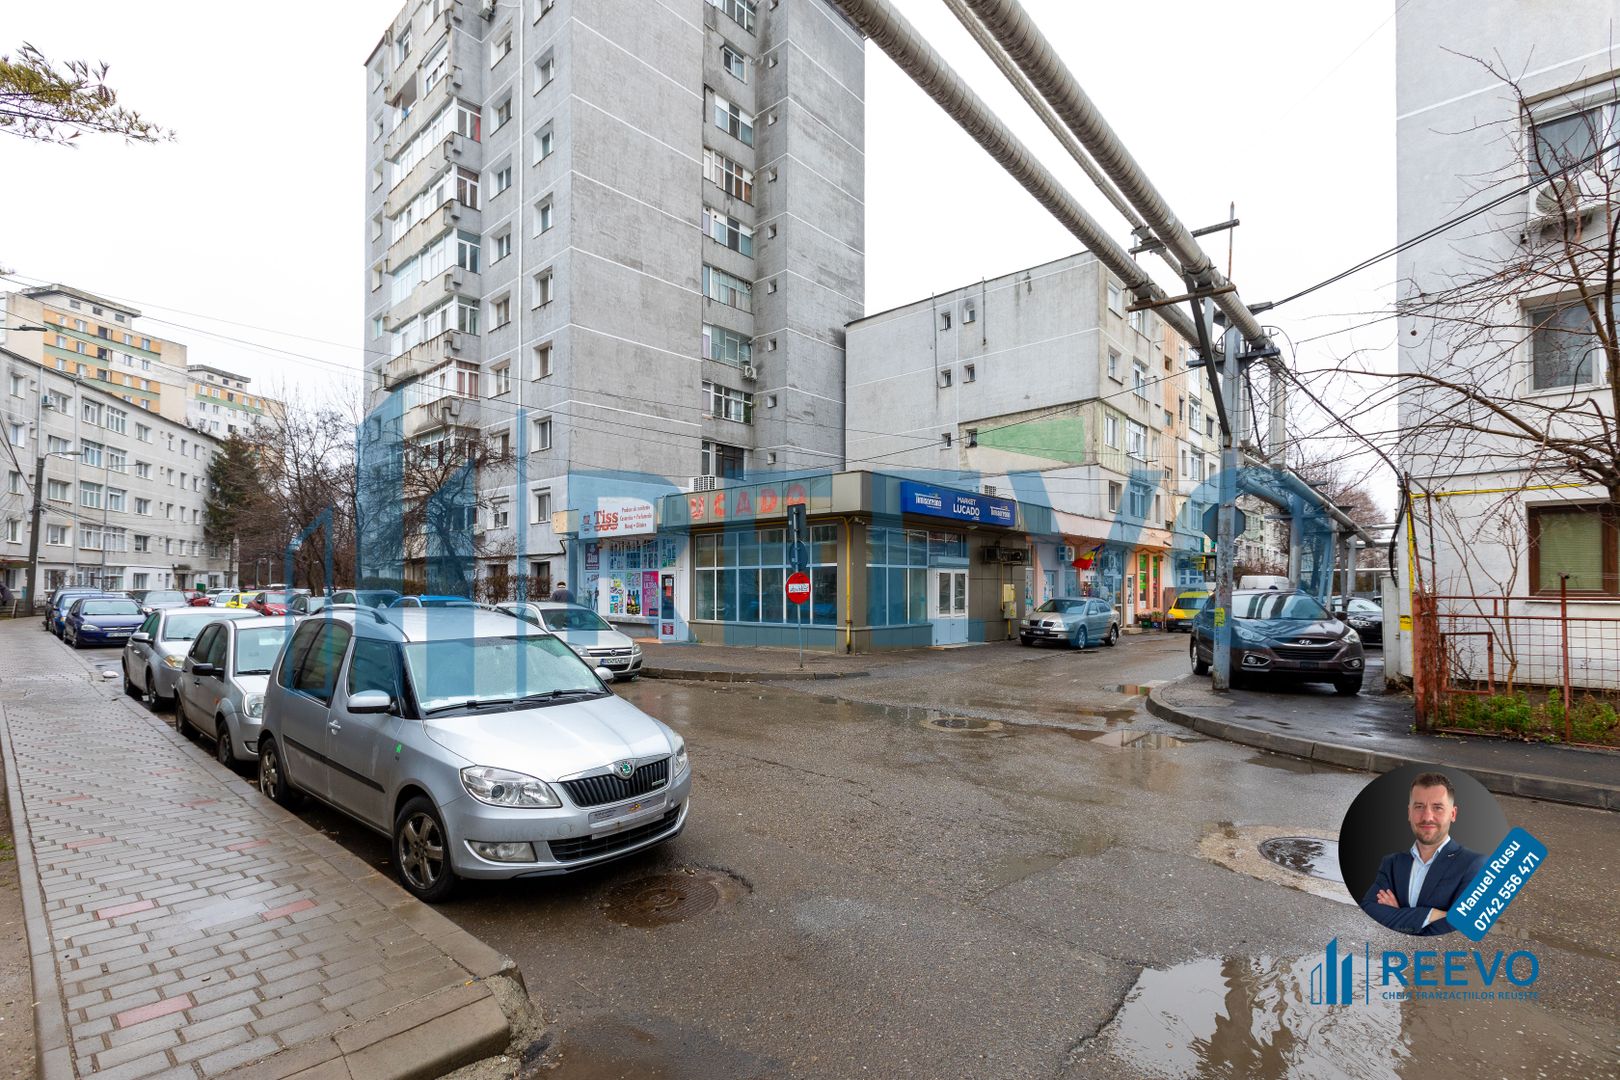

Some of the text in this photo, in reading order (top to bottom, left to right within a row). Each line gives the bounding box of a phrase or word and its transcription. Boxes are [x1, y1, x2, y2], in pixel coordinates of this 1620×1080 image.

[957, 497, 976, 505] MARKET
[953, 503, 981, 516] LUCADO
[594, 510, 619, 525] Tiss
